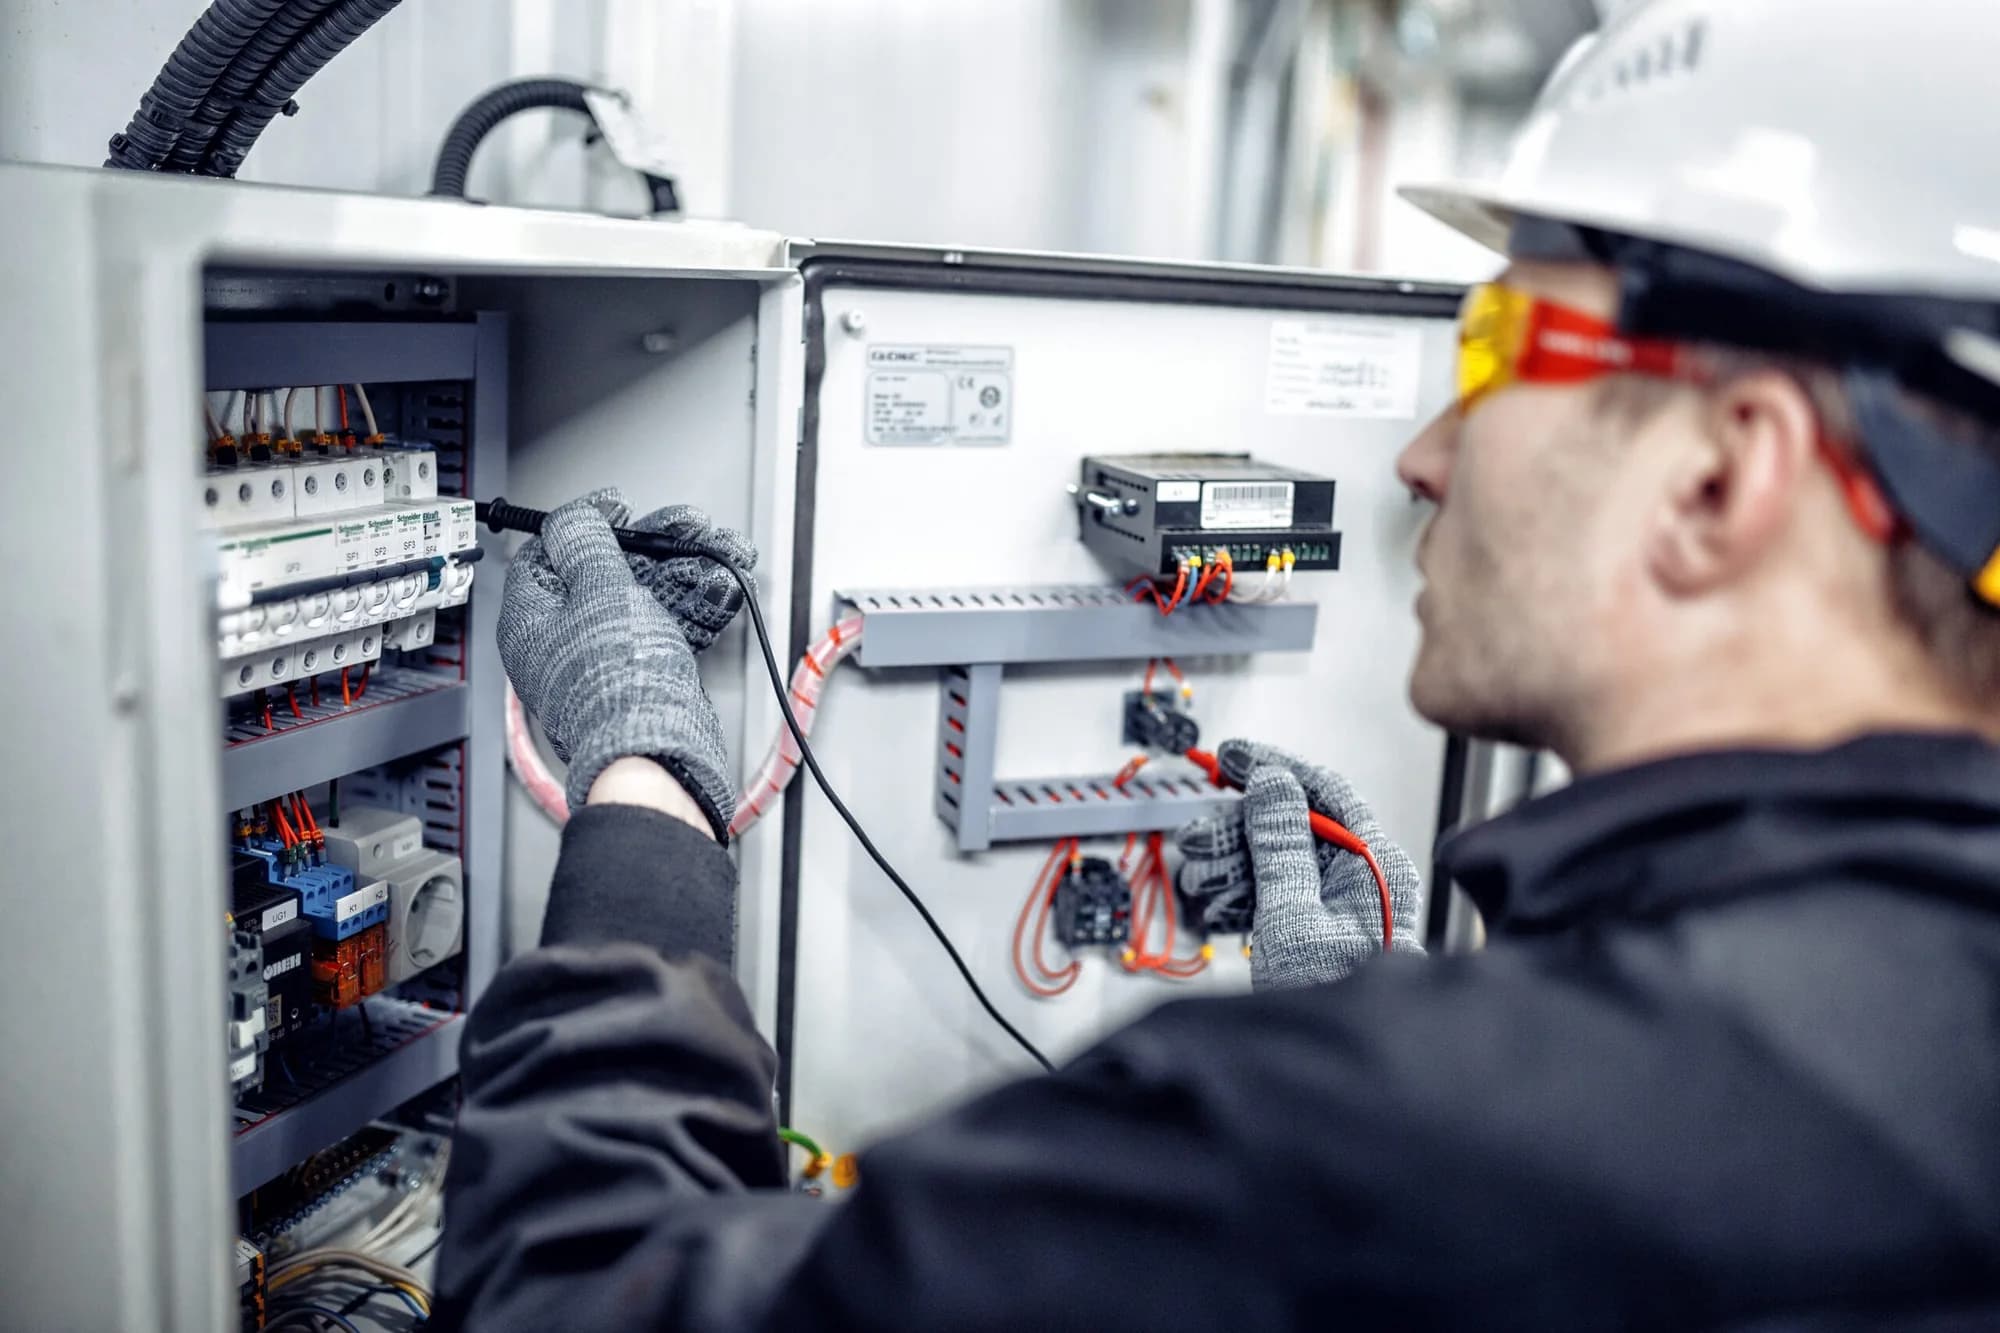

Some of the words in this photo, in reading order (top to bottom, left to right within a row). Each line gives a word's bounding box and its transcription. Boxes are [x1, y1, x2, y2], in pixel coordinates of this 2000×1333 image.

[450, 505, 473, 514] Schneider
[397, 513, 422, 523] Schneider
[338, 524, 365, 534] Schneider
[368, 519, 394, 529] Schneider
[403, 540, 416, 551] SF3
[374, 546, 387, 557] SF2
[346, 552, 359, 562] SF1
[375, 889, 384, 900] K2
[349, 904, 358, 913] K1
[272, 910, 287, 923] UG1
